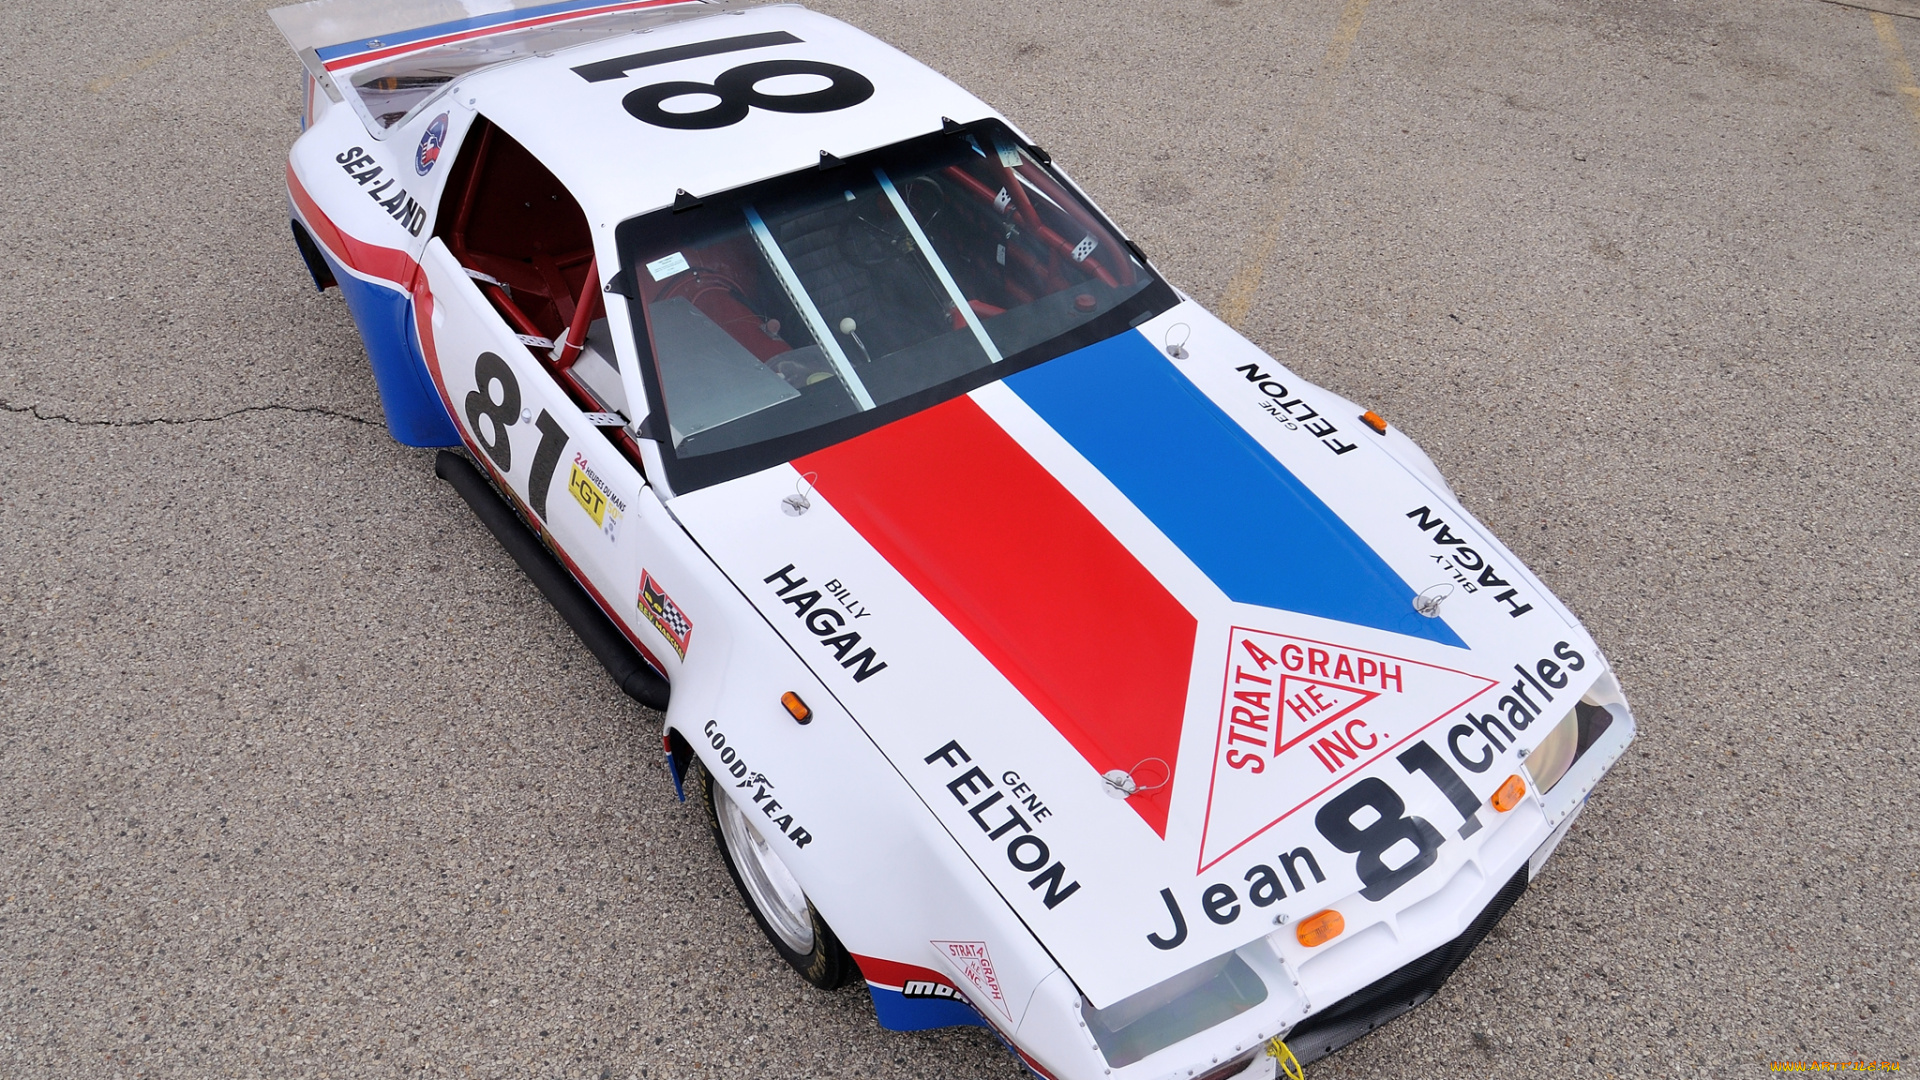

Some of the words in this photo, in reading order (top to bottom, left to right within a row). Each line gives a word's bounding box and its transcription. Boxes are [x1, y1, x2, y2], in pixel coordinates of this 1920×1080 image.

[569, 30, 875, 130] 81
[465, 351, 570, 525] 81
[1234, 363, 1359, 455] FELTON
[1258, 400, 1299, 431] GENE
[574, 452, 588, 470] 24
[585, 466, 605, 490] HEURES
[602, 485, 612, 497] DU
[610, 493, 626, 512] MANS
[1405, 505, 1534, 618] HAGAN
[1429, 555, 1478, 594] BILLY
[763, 563, 888, 683] HAGAN
[824, 578, 871, 619] BILLY
[1285, 684, 1338, 722] H.E.
[1308, 718, 1389, 774] INC.
[923, 739, 1081, 911] FELTON
[1002, 770, 1053, 824] GENE
[1146, 846, 1326, 951] Jean
[1314, 739, 1484, 902] 81
[1447, 640, 1586, 773] Charles
[965, 966, 982, 989] INC.
